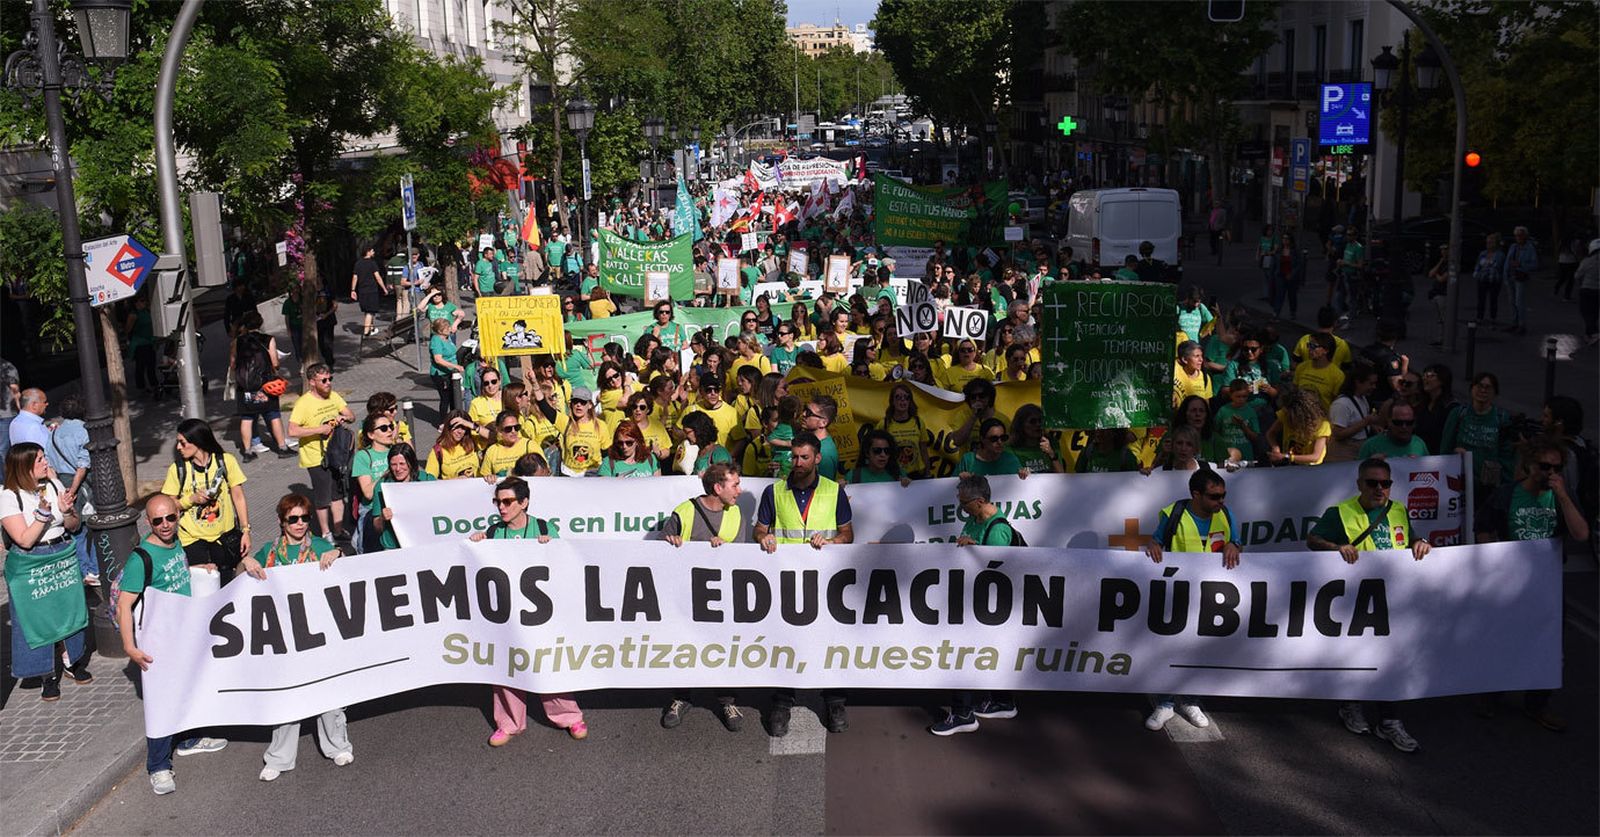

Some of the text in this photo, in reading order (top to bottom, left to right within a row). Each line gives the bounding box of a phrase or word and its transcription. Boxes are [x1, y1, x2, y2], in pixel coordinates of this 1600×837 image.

[1323, 85, 1344, 112] P
[1296, 143, 1305, 162] P
[1331, 144, 1354, 155] LIBRE
[881, 184, 891, 194] EL
[910, 203, 922, 215] EN
[924, 204, 940, 216] TUS
[941, 205, 968, 219] MANOS
[610, 246, 669, 263] VALLEKAS
[120, 261, 136, 270] Metro
[1077, 290, 1174, 318] RECURSOS
[896, 303, 937, 336] NO
[945, 309, 985, 338] NO
[1103, 339, 1165, 355] TEMPRANA
[432, 511, 672, 535] Doces en luch
[1408, 508, 1437, 519] CGT
[209, 565, 554, 658] SALVEMOS
[584, 565, 662, 622] LA
[692, 561, 1065, 628] EDUCACIÓN
[1098, 567, 1391, 638] PÚBLICA
[442, 633, 1133, 678] Su privatización, nuestra ruina
